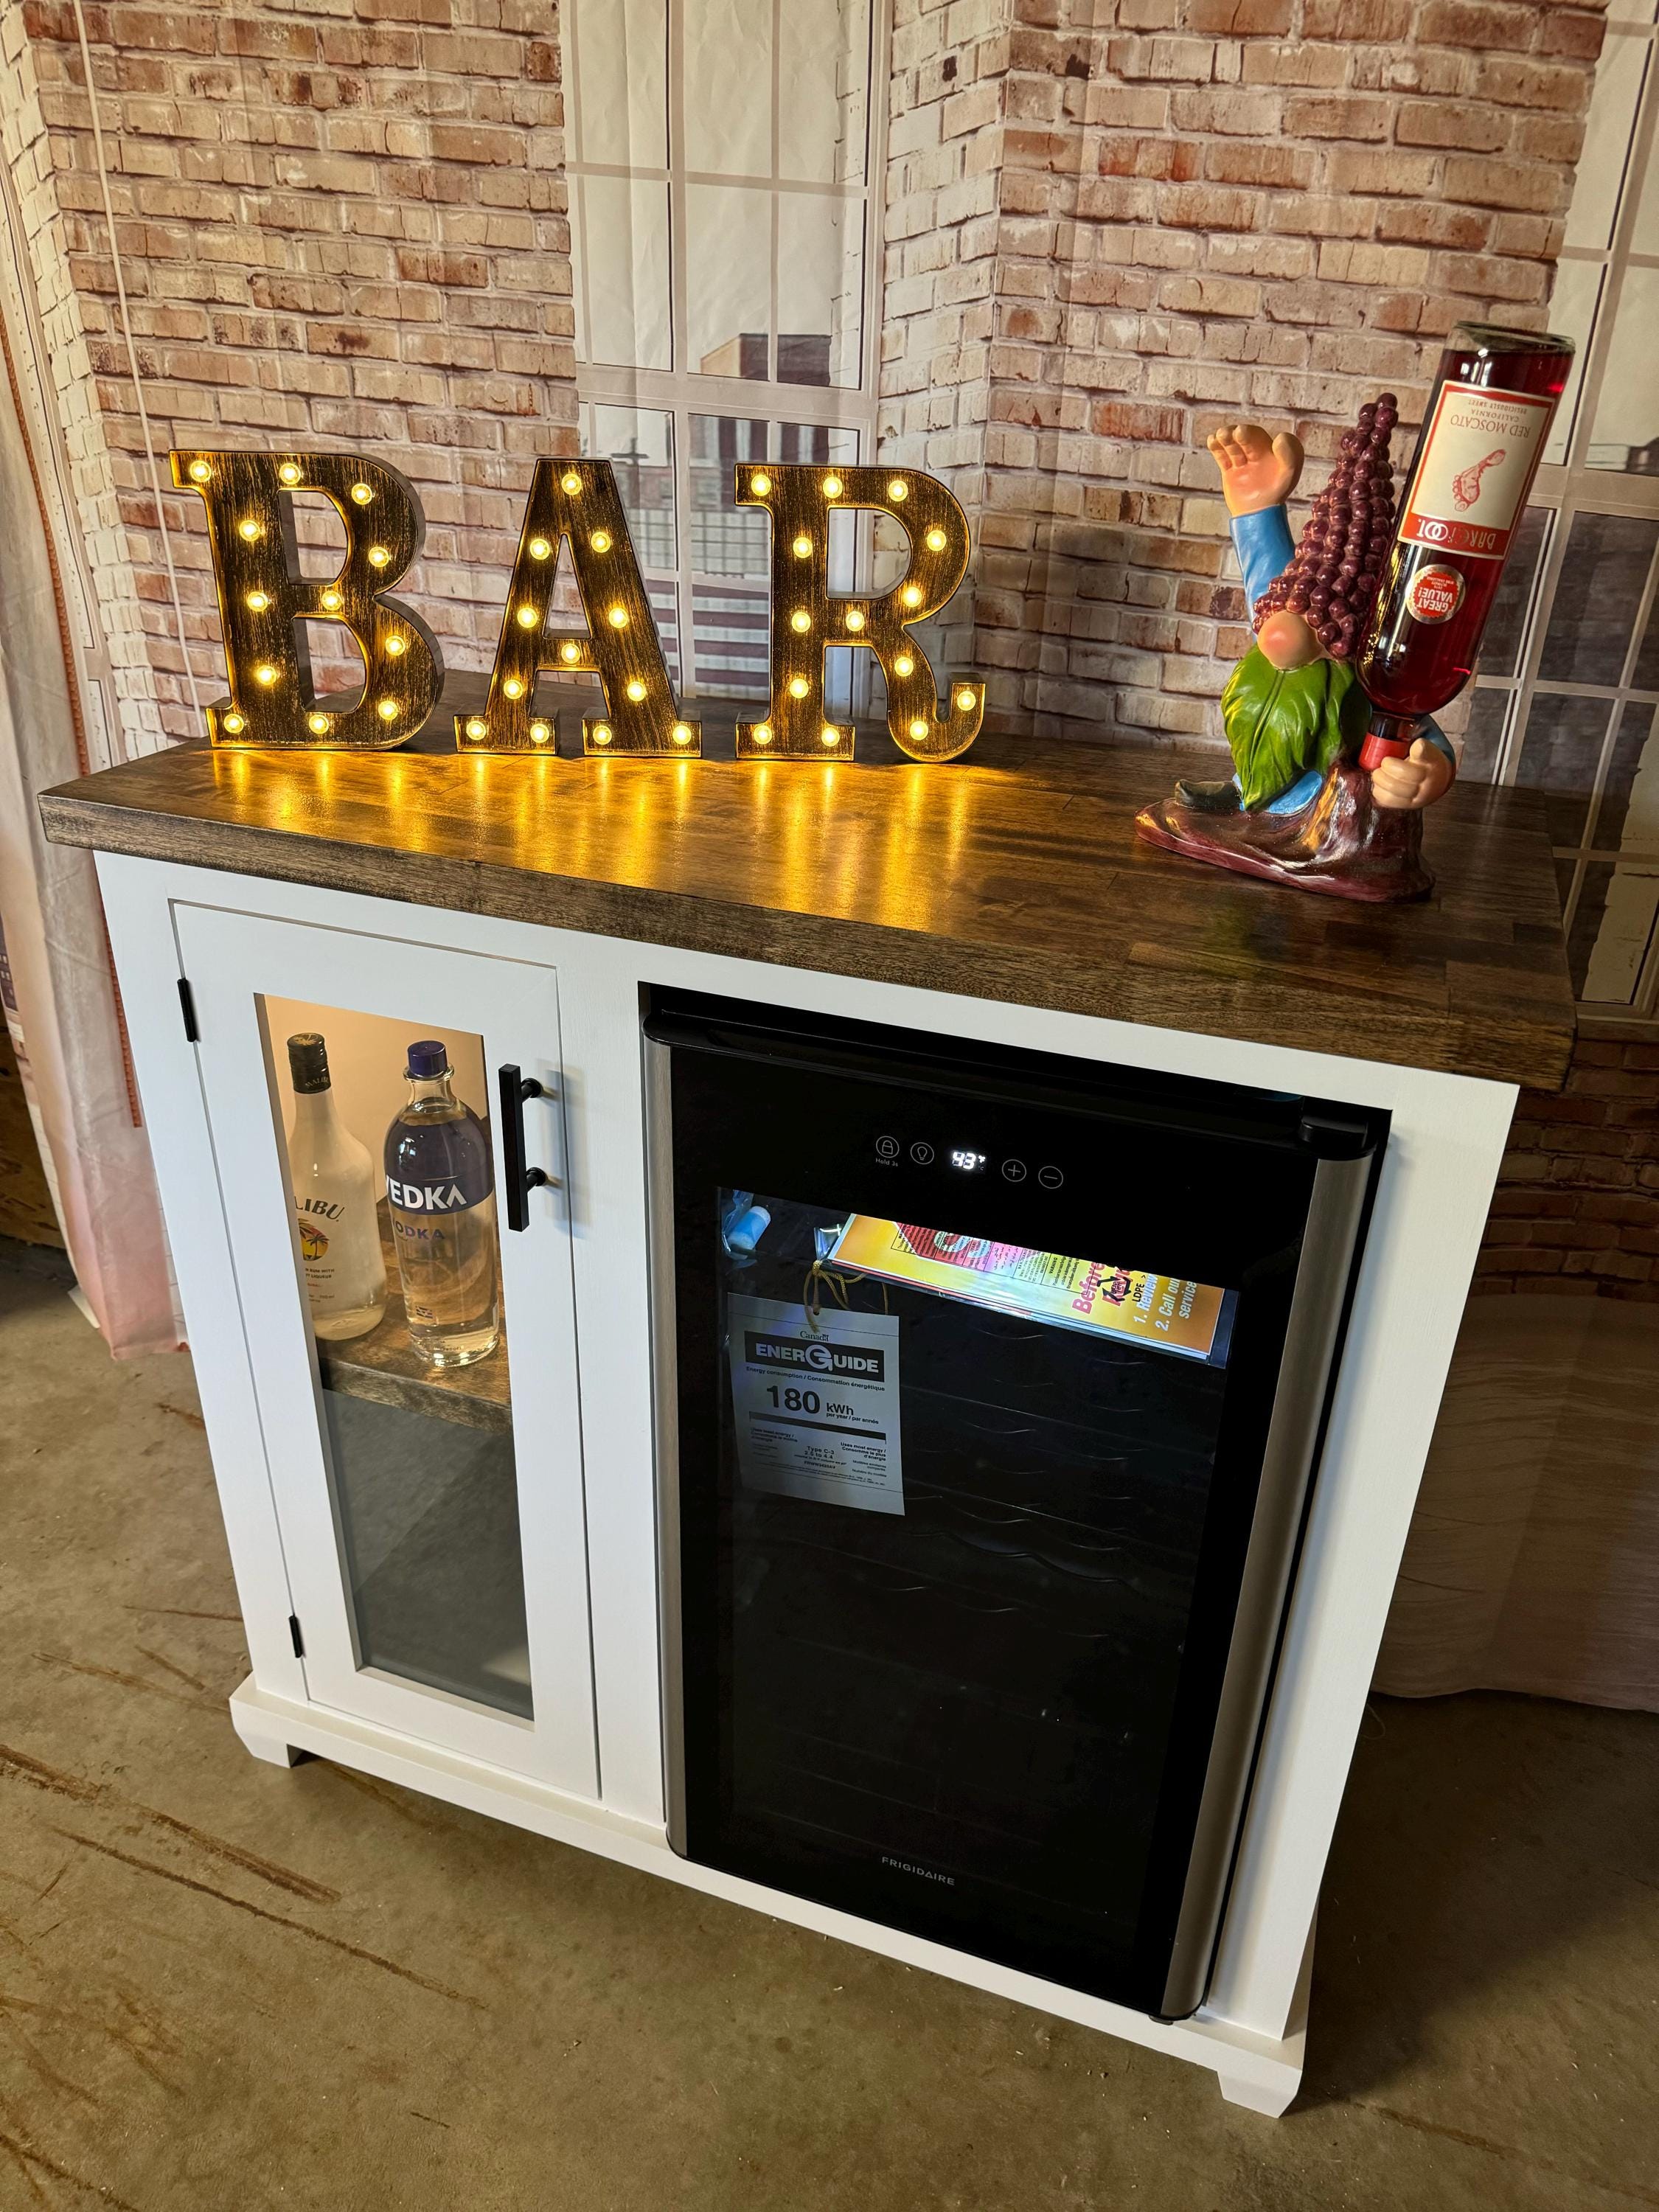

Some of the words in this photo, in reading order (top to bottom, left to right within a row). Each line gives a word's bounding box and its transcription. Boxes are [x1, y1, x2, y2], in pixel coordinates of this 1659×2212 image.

[1450, 414, 1508, 434] MOSCATO
[1471, 408, 1520, 422] CALIFORNIA
[1509, 425, 1531, 438] RED
[1416, 597, 1449, 613] GREAT
[1418, 587, 1453, 603] VALUE!
[170, 448, 986, 763] BAR
[875, 1157, 890, 1166] Hold
[392, 1217, 445, 1239] ODKA
[1071, 1262, 1105, 1315] Before
[1132, 1282, 1145, 1302] LDPE
[1158, 1293, 1177, 1317] Call
[1155, 1319, 1170, 1332] 2.
[745, 1366, 766, 1374] Energy
[766, 1370, 803, 1380] consumption
[807, 1375, 850, 1386] Consommation
[767, 1385, 821, 1414] 180
[826, 1402, 854, 1416] kWh
[807, 1445, 822, 1453] Type
[881, 1856, 956, 1886] FRIGIDAIRE
